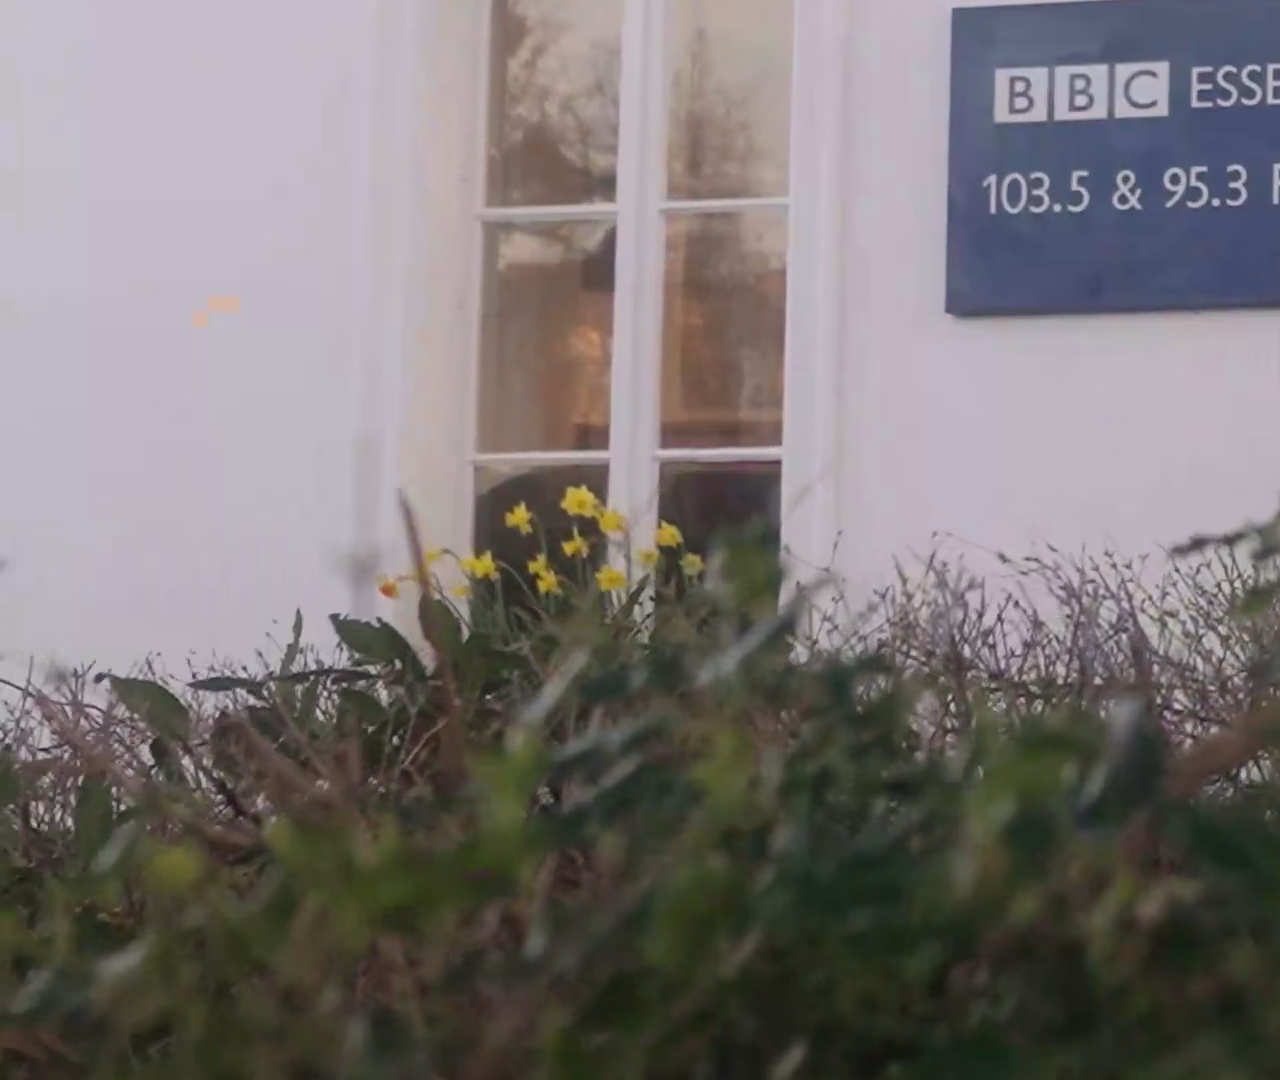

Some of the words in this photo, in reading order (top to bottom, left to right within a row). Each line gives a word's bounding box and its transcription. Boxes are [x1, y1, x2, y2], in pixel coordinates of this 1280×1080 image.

[1000, 65, 1166, 120] BBC
[982, 170, 1090, 214] 103.5
[1111, 170, 1143, 210] &
[1163, 164, 1248, 208] 95.3
